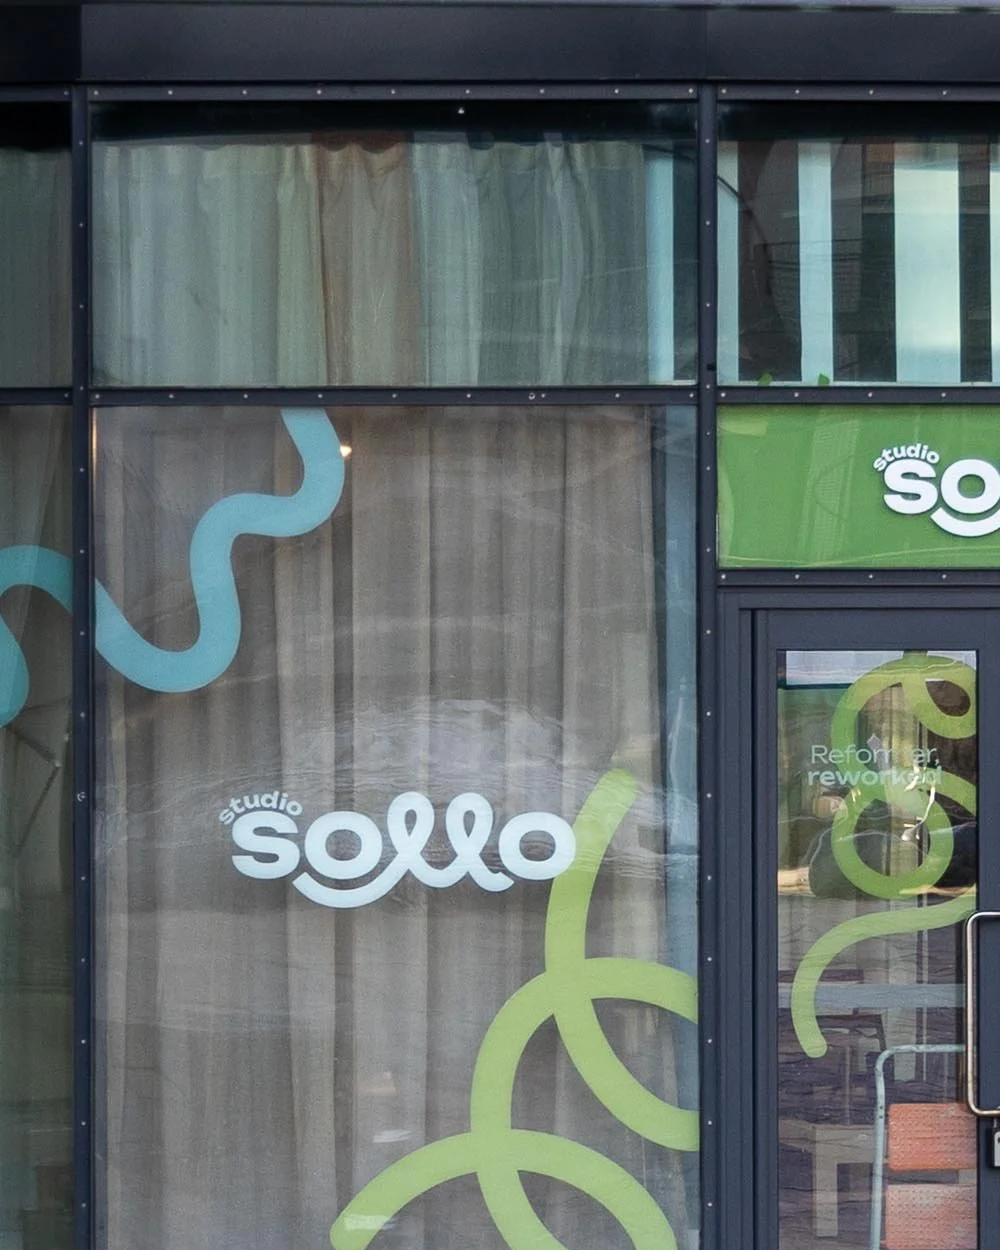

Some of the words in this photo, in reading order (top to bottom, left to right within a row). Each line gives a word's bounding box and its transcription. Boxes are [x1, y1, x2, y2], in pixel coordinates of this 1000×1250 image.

[873, 443, 940, 472] studio
[218, 790, 303, 826] studio
[231, 791, 576, 909] sollo
